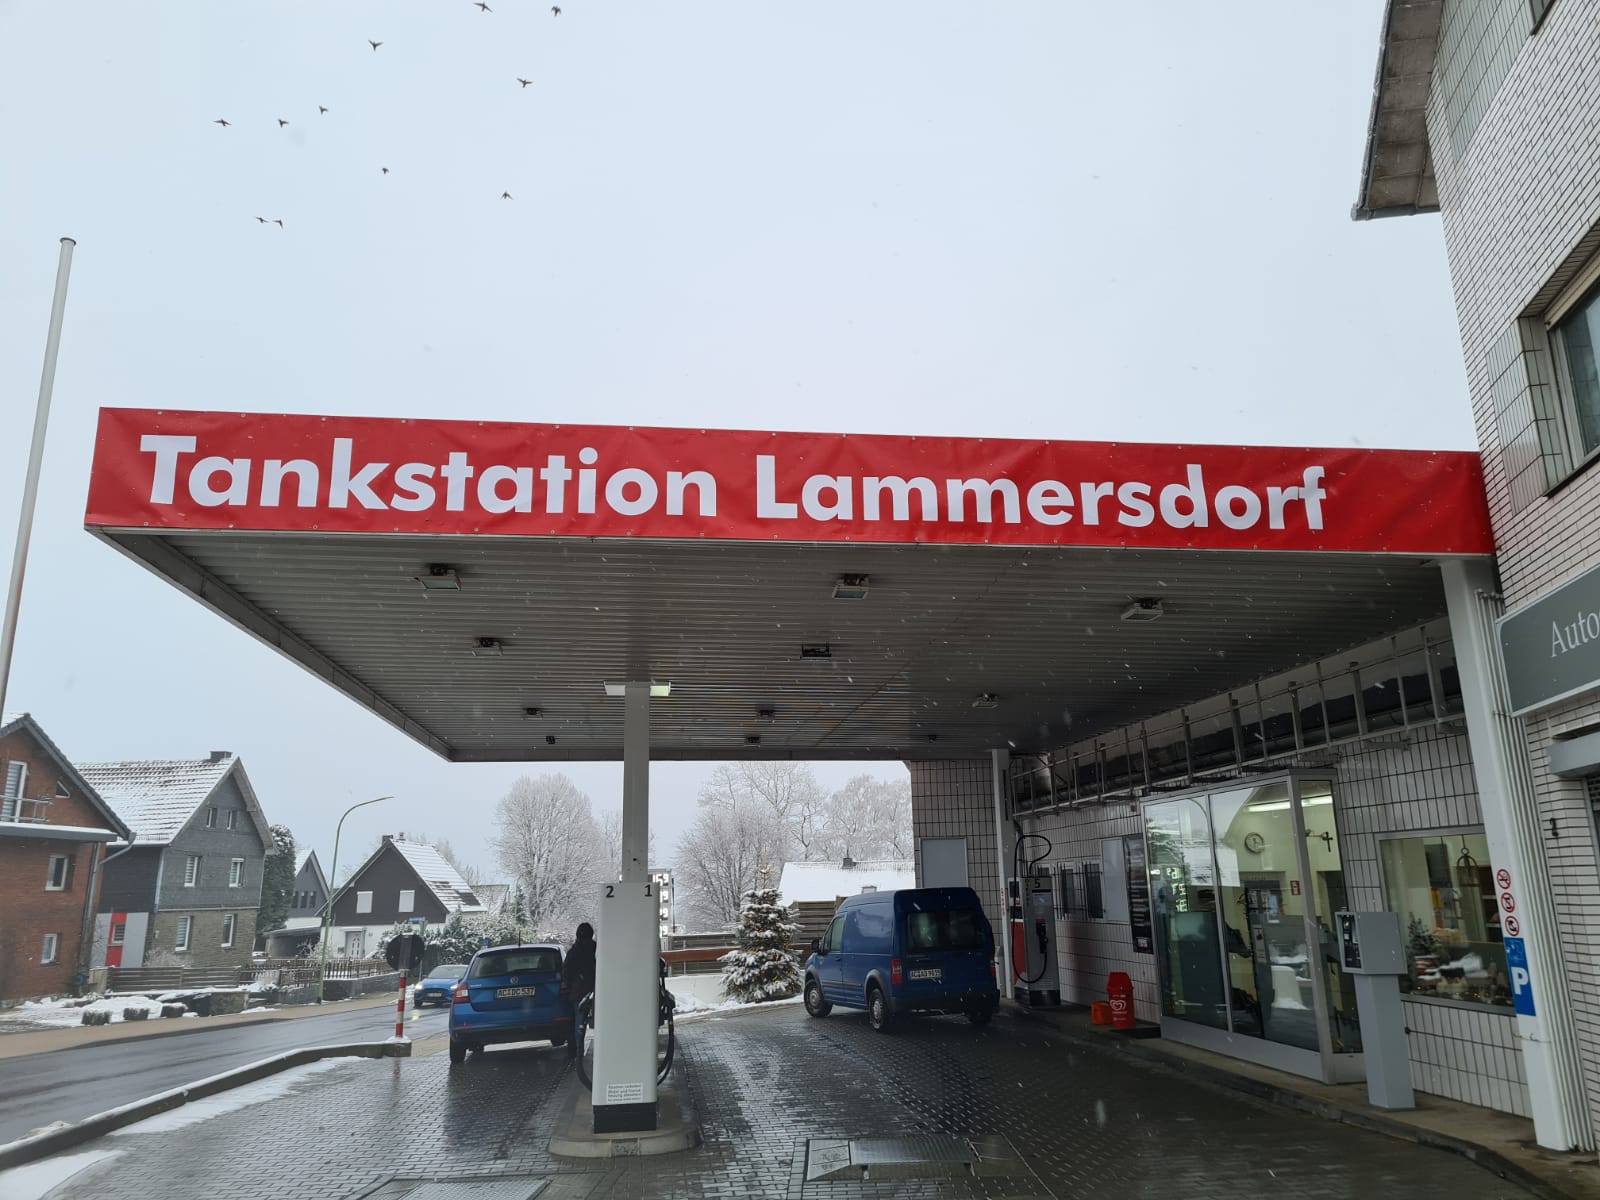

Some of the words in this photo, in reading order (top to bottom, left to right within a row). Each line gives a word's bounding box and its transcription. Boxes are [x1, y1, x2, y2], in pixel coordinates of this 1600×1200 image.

[140, 434, 718, 518] Tankstation
[756, 454, 1327, 531] Lammersdorf
[1551, 610, 1600, 658] Auto
[605, 885, 615, 898] 2
[644, 884, 653, 897] 1
[1034, 878, 1041, 889] 5
[1511, 966, 1529, 996] P
